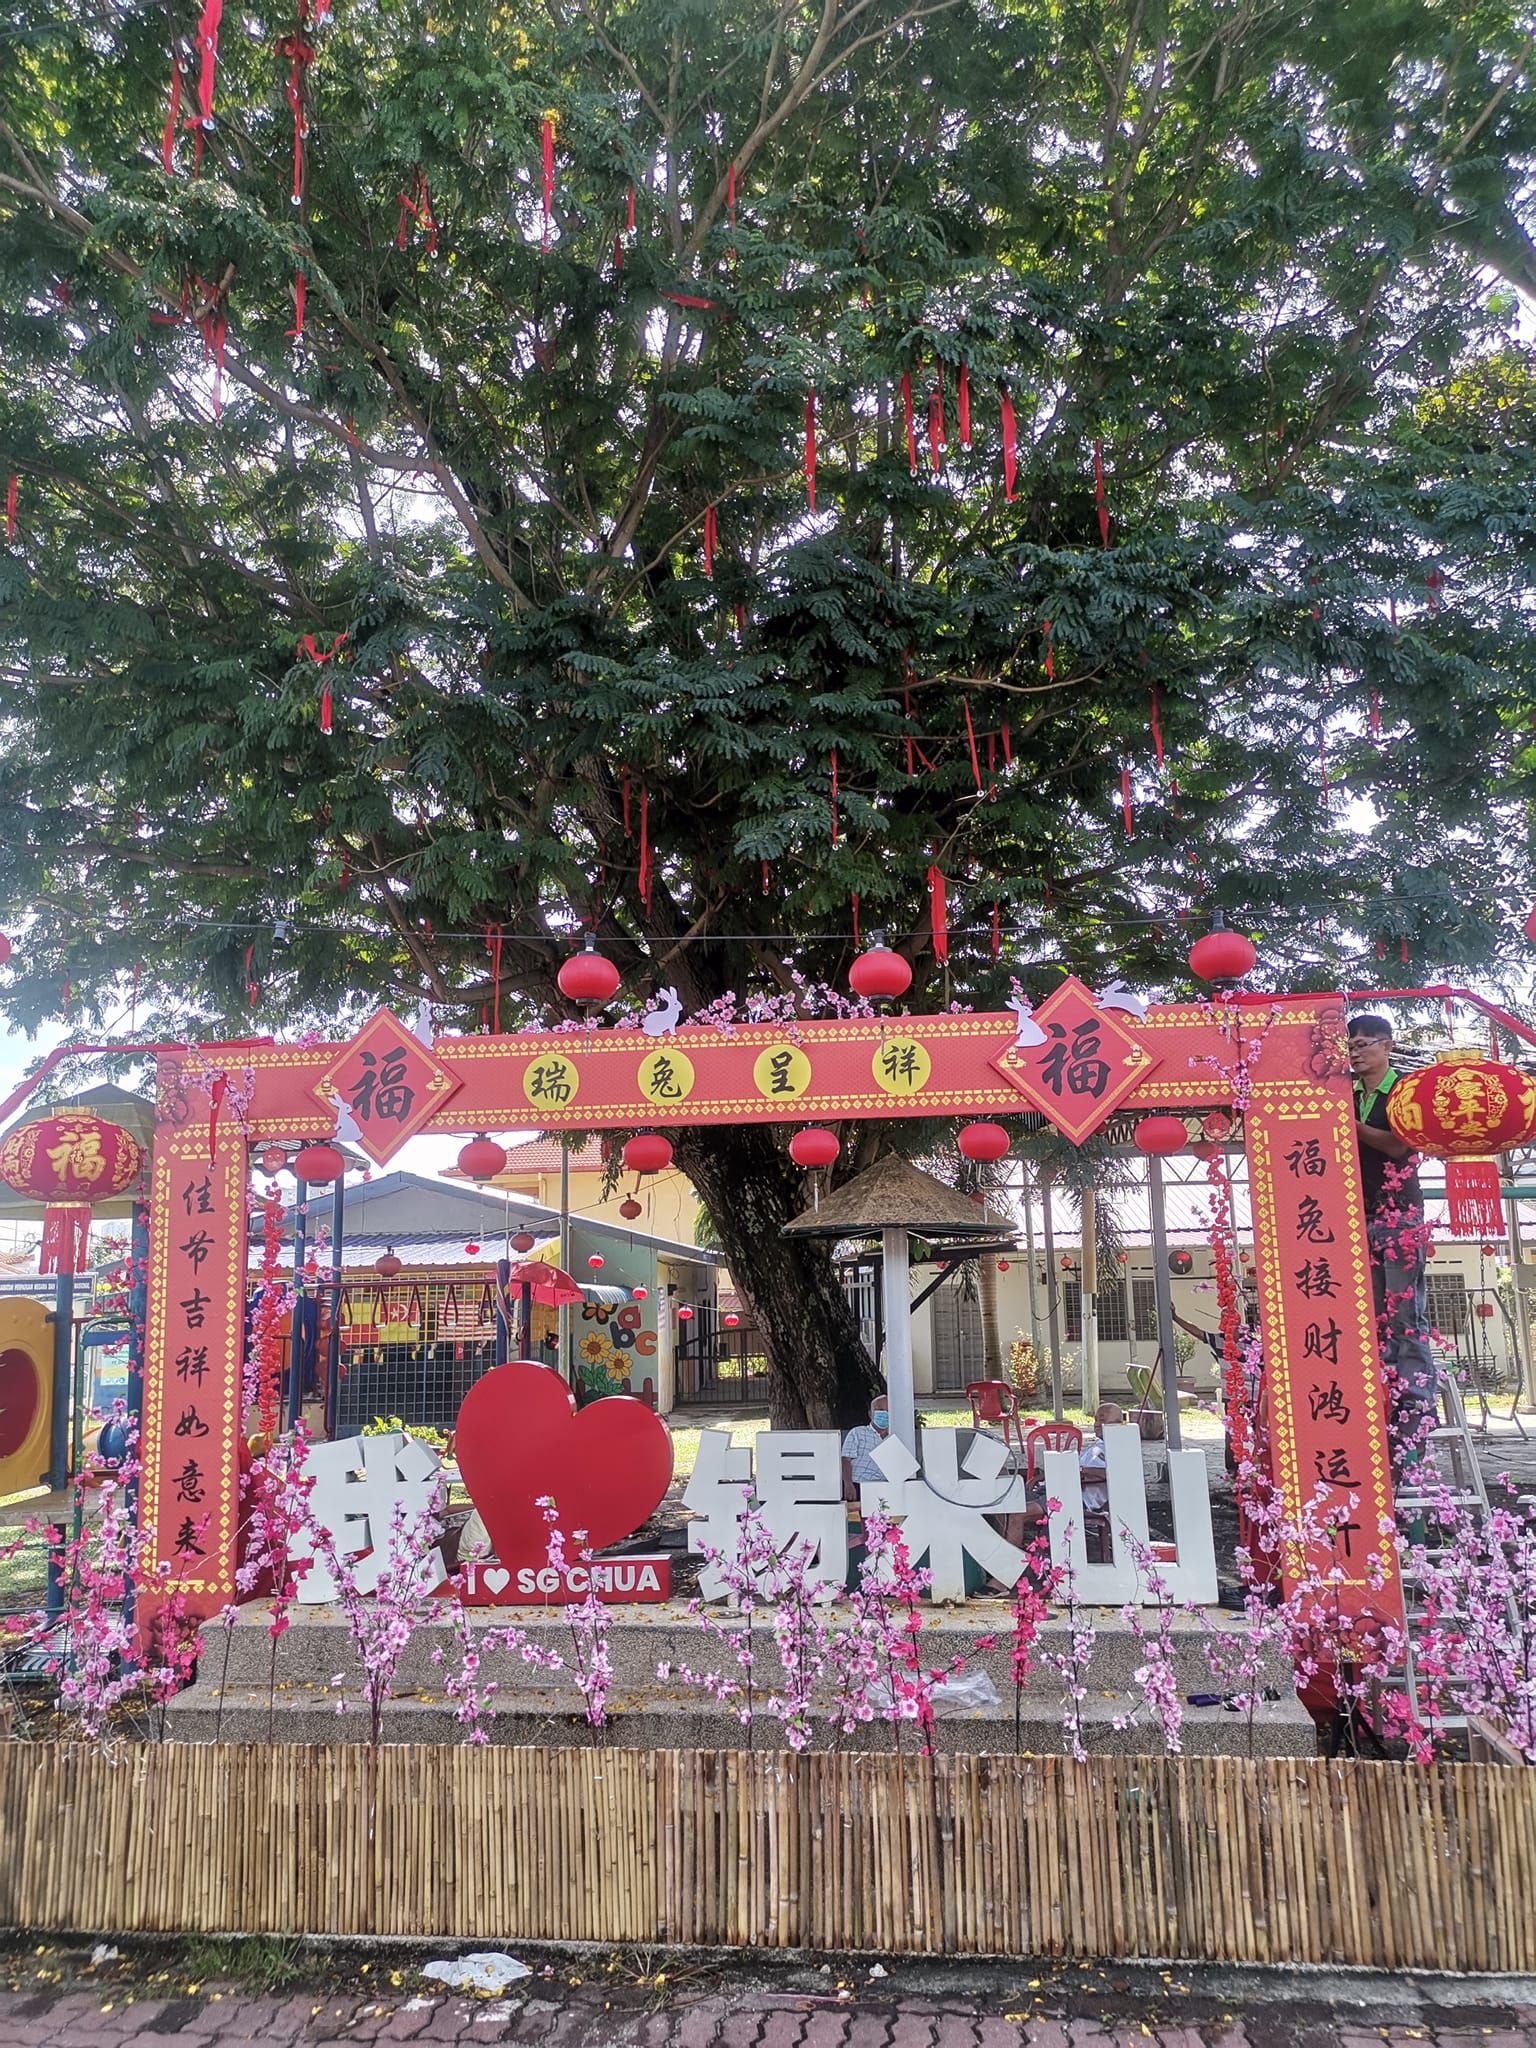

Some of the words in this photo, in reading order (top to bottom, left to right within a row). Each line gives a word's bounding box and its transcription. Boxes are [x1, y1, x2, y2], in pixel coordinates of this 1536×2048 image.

[348, 1046, 415, 1123] 福
[531, 1044, 921, 1104] 瑞兔呈祥
[1036, 1018, 1111, 1099] 福
[46, 1131, 106, 1182] 福
[171, 1175, 216, 1557] 佳节吉祥如意来
[288, 1434, 446, 1604] 我
[517, 1567, 560, 1593] SG
[566, 1565, 661, 1593] CHUA
